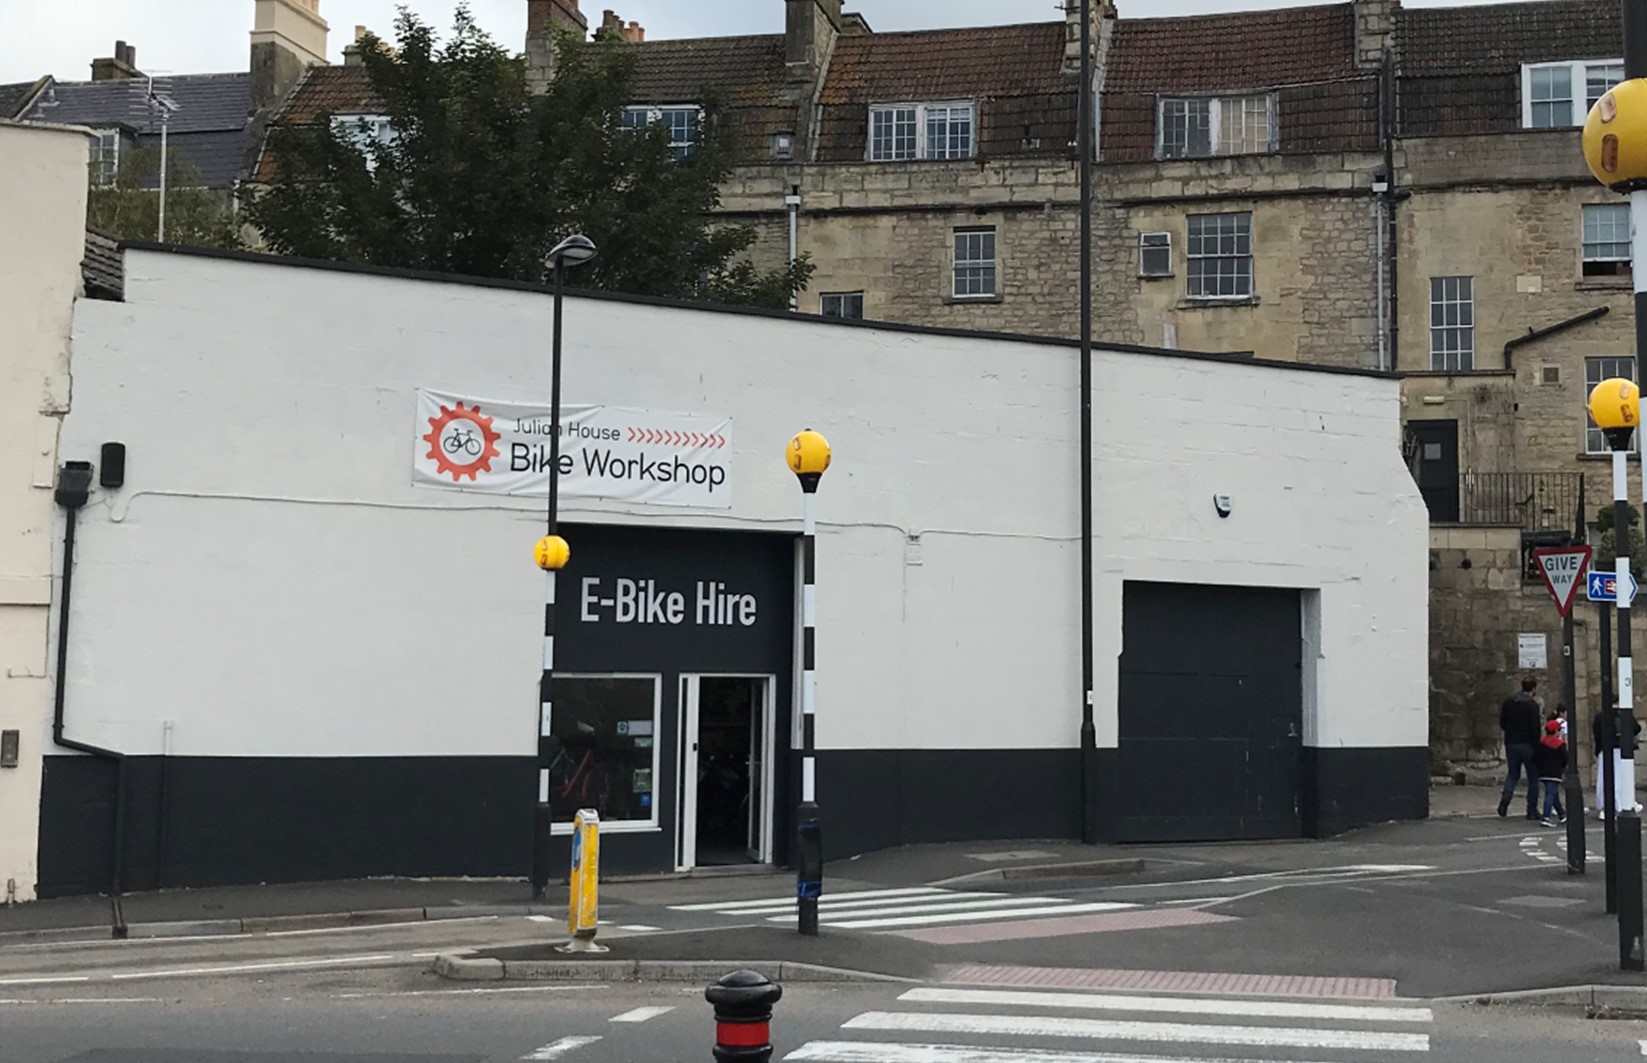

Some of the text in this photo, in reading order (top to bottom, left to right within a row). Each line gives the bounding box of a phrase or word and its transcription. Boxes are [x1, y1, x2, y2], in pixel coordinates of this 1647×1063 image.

[568, 421, 621, 441] House
[510, 442, 726, 493] Bike Workshop
[1545, 556, 1578, 571] GIVE
[1551, 574, 1573, 584] WAY
[580, 576, 757, 626] E-Bike Hire
